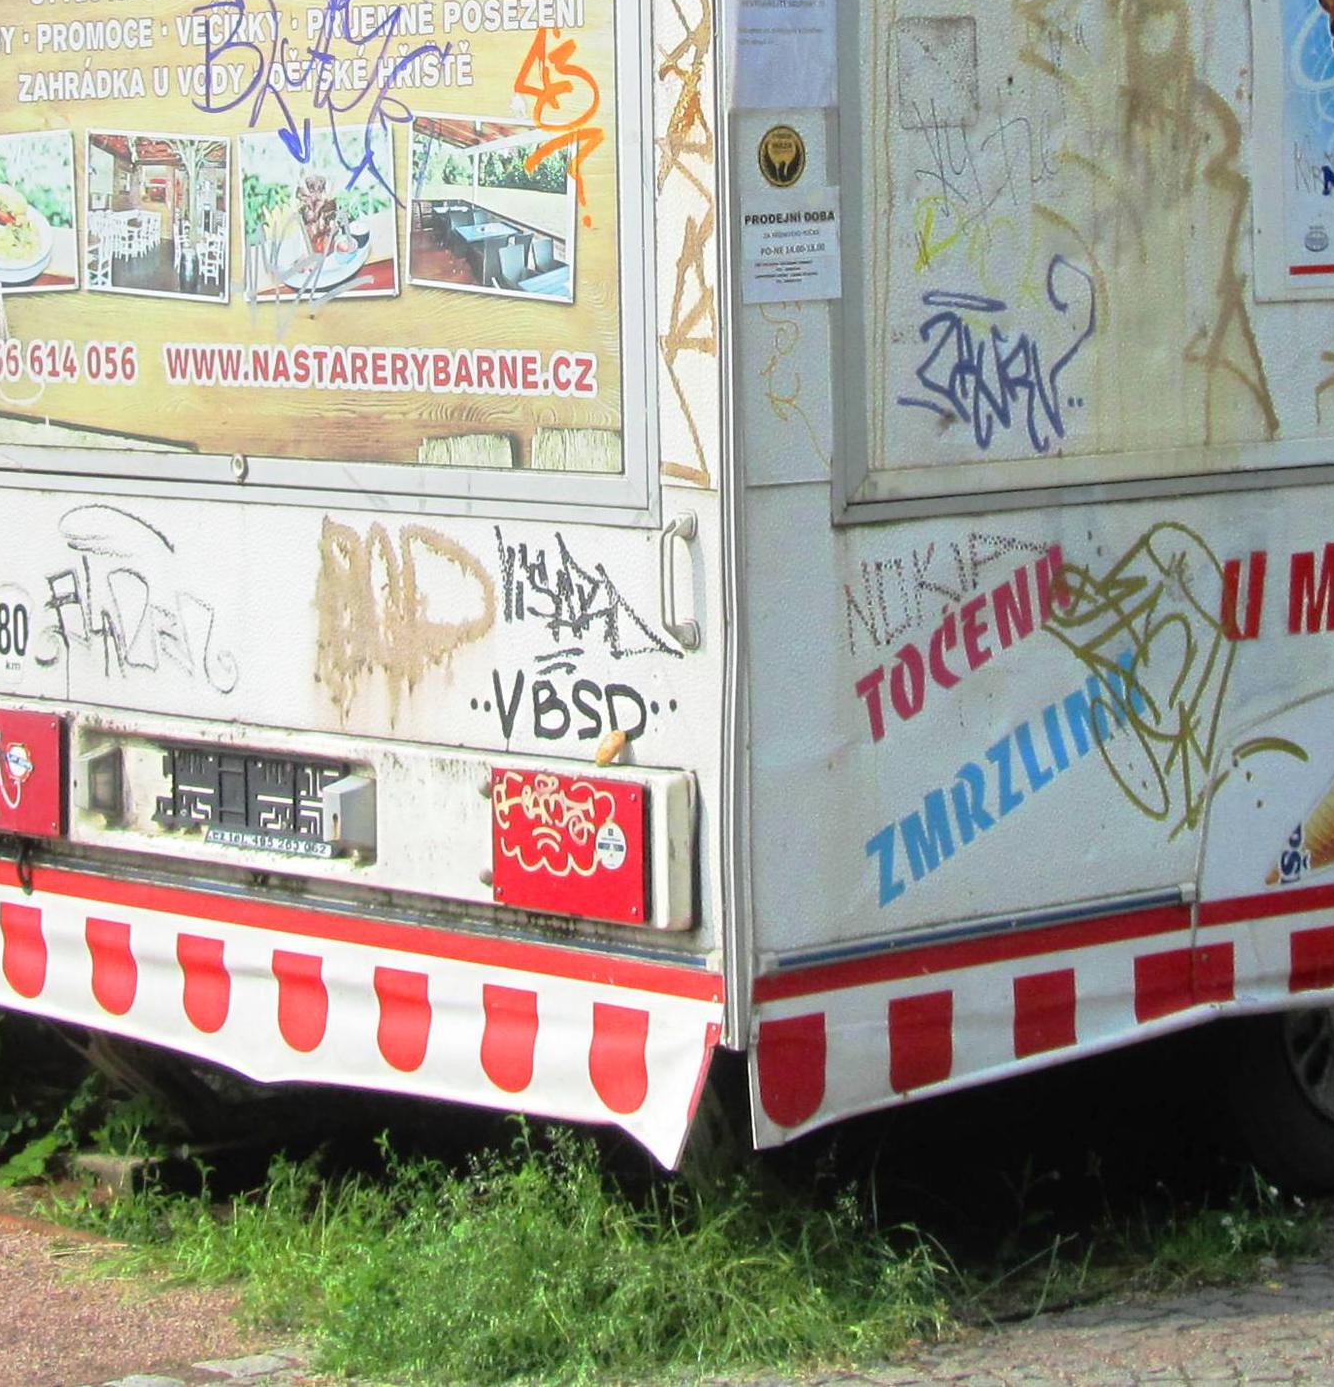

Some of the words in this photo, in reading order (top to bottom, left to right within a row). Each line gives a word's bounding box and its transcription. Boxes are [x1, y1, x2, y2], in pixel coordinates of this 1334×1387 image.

[36, 17, 153, 53] PROMOCE
[175, 1, 282, 47] VEČÍRKY
[18, 57, 145, 103] ZAHRÁDKA
[152, 67, 170, 98] U
[177, 62, 245, 97] VODY
[269, 44, 368, 93] DĚTSKÉ
[744, 212, 801, 225] PRODEJNÍ
[804, 210, 836, 223] DOBA
[30, 344, 78, 378] 614
[87, 345, 136, 380] 056
[166, 347, 597, 392] WWW.NASTARERYBARNE.CZ
[1220, 550, 1267, 641] U
[864, 647, 1147, 909] ZMRZLINA
